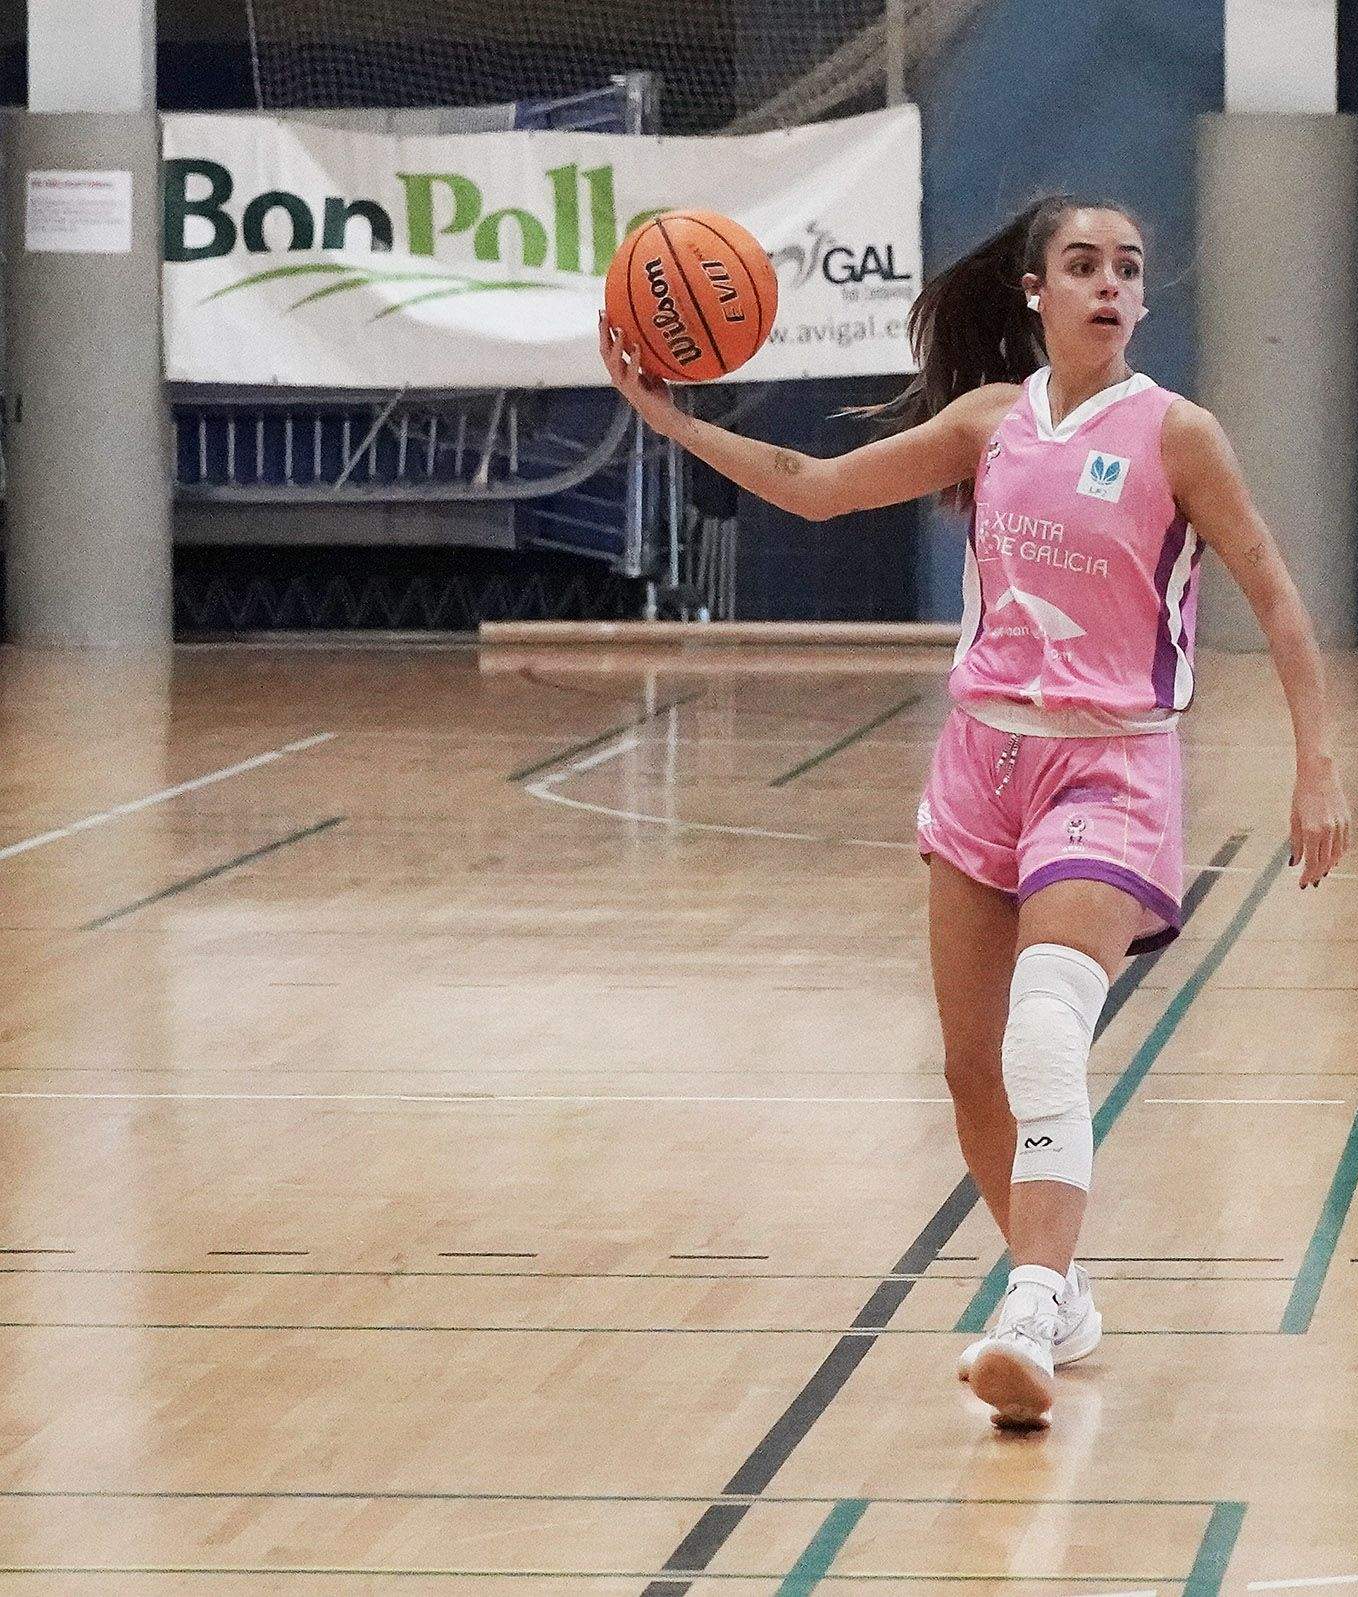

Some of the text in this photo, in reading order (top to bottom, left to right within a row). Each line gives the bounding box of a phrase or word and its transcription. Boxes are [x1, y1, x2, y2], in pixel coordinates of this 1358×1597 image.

[163, 158, 674, 276] BonPoll
[644, 256, 703, 366] Wilson
[768, 315, 912, 348] w.avigal.e
[991, 510, 1065, 543] XUNTA
[1019, 541, 1109, 579] GALICIA
